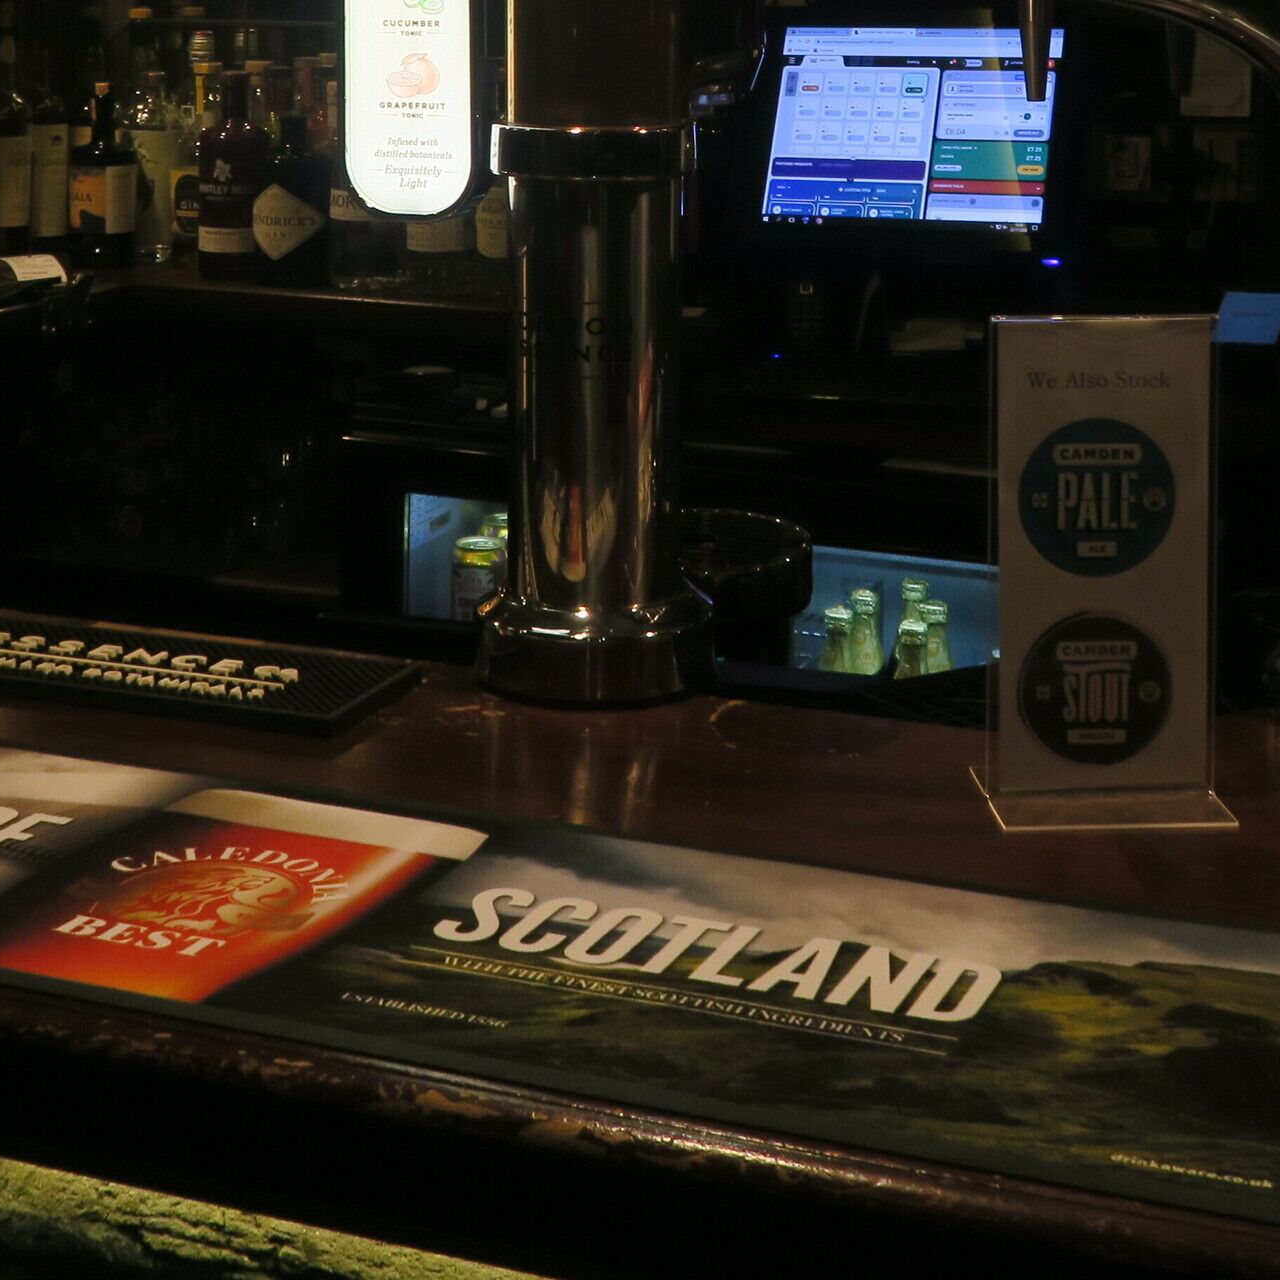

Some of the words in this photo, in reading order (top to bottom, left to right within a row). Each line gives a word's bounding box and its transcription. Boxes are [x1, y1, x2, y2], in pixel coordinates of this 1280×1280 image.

[382, 19, 441, 28] CUCUMBER
[379, 101, 447, 110] GRAPEFRUIT
[388, 137, 418, 147] Infused
[419, 137, 438, 146] with
[374, 148, 407, 159] distilled
[409, 149, 453, 160] botanicals
[384, 164, 442, 178] Exquisitely
[399, 177, 427, 191] Light
[1028, 371, 1057, 388] We
[1065, 370, 1108, 388] Also
[1115, 370, 1171, 389] Stock
[1060, 448, 1135, 460] CAMDEN
[1056, 471, 1138, 530] PALE
[1088, 545, 1107, 553] ALE
[1062, 645, 1131, 656] CAMDEN
[1061, 659, 1132, 723] STOUT
[51, 913, 228, 958] BEST
[432, 887, 1003, 1022] SCOTLAND
[340, 990, 467, 1022] ESTABLISHED
[442, 955, 505, 976] WITH
[507, 965, 550, 982] THE
[552, 974, 629, 996] FINEST
[632, 986, 747, 1017] SCOTTISH
[748, 1005, 906, 1045] INGREDIENTS
[1109, 1152, 1274, 1190] drinkaware.co.uk
